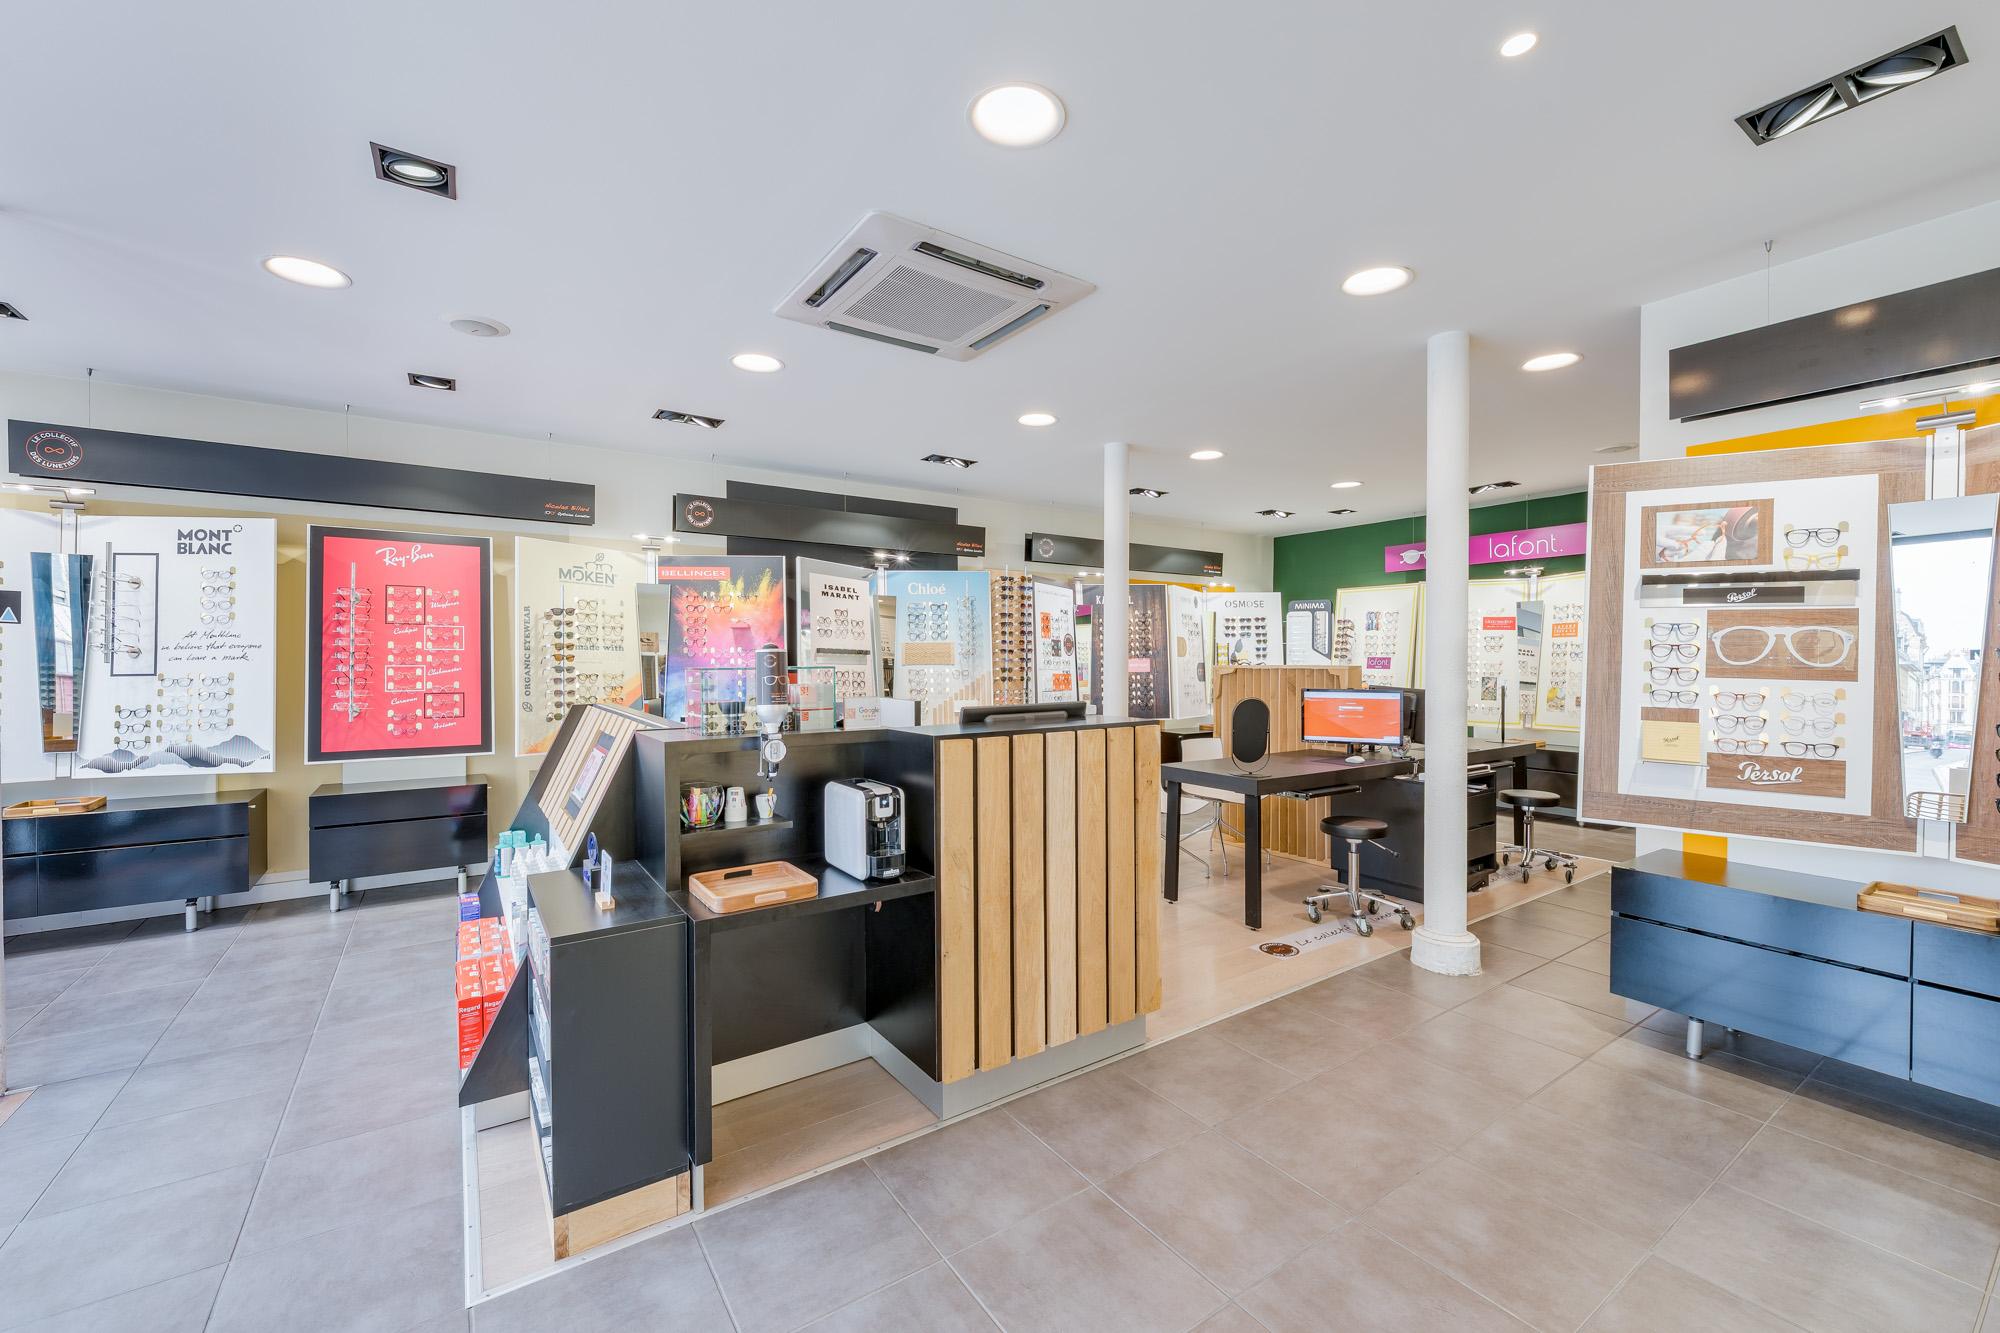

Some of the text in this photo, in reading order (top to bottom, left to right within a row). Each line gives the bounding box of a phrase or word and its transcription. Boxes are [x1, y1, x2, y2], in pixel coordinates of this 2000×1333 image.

[31, 432, 78, 448] LE COLLECTIF
[30, 451, 79, 468] DES LUNETIERS
[177, 529, 232, 541] MONT
[177, 542, 232, 555] BLANC
[376, 544, 435, 568] Ray-Ban
[824, 583, 858, 594] ISABEL
[907, 582, 946, 595] Chloé
[821, 590, 860, 601] MARANT
[1726, 587, 1757, 603] Persol
[1224, 600, 1265, 609] OSMOSE
[1294, 602, 1325, 610] MINIMA
[523, 606, 531, 652] EYEWEAR
[174, 643, 202, 651] believe
[206, 641, 225, 651] that
[228, 643, 263, 653] everyone
[602, 644, 624, 652] with
[1737, 761, 1803, 785] Persol
[459, 1003, 481, 1013] Regard
[484, 999, 502, 1008] Regar
